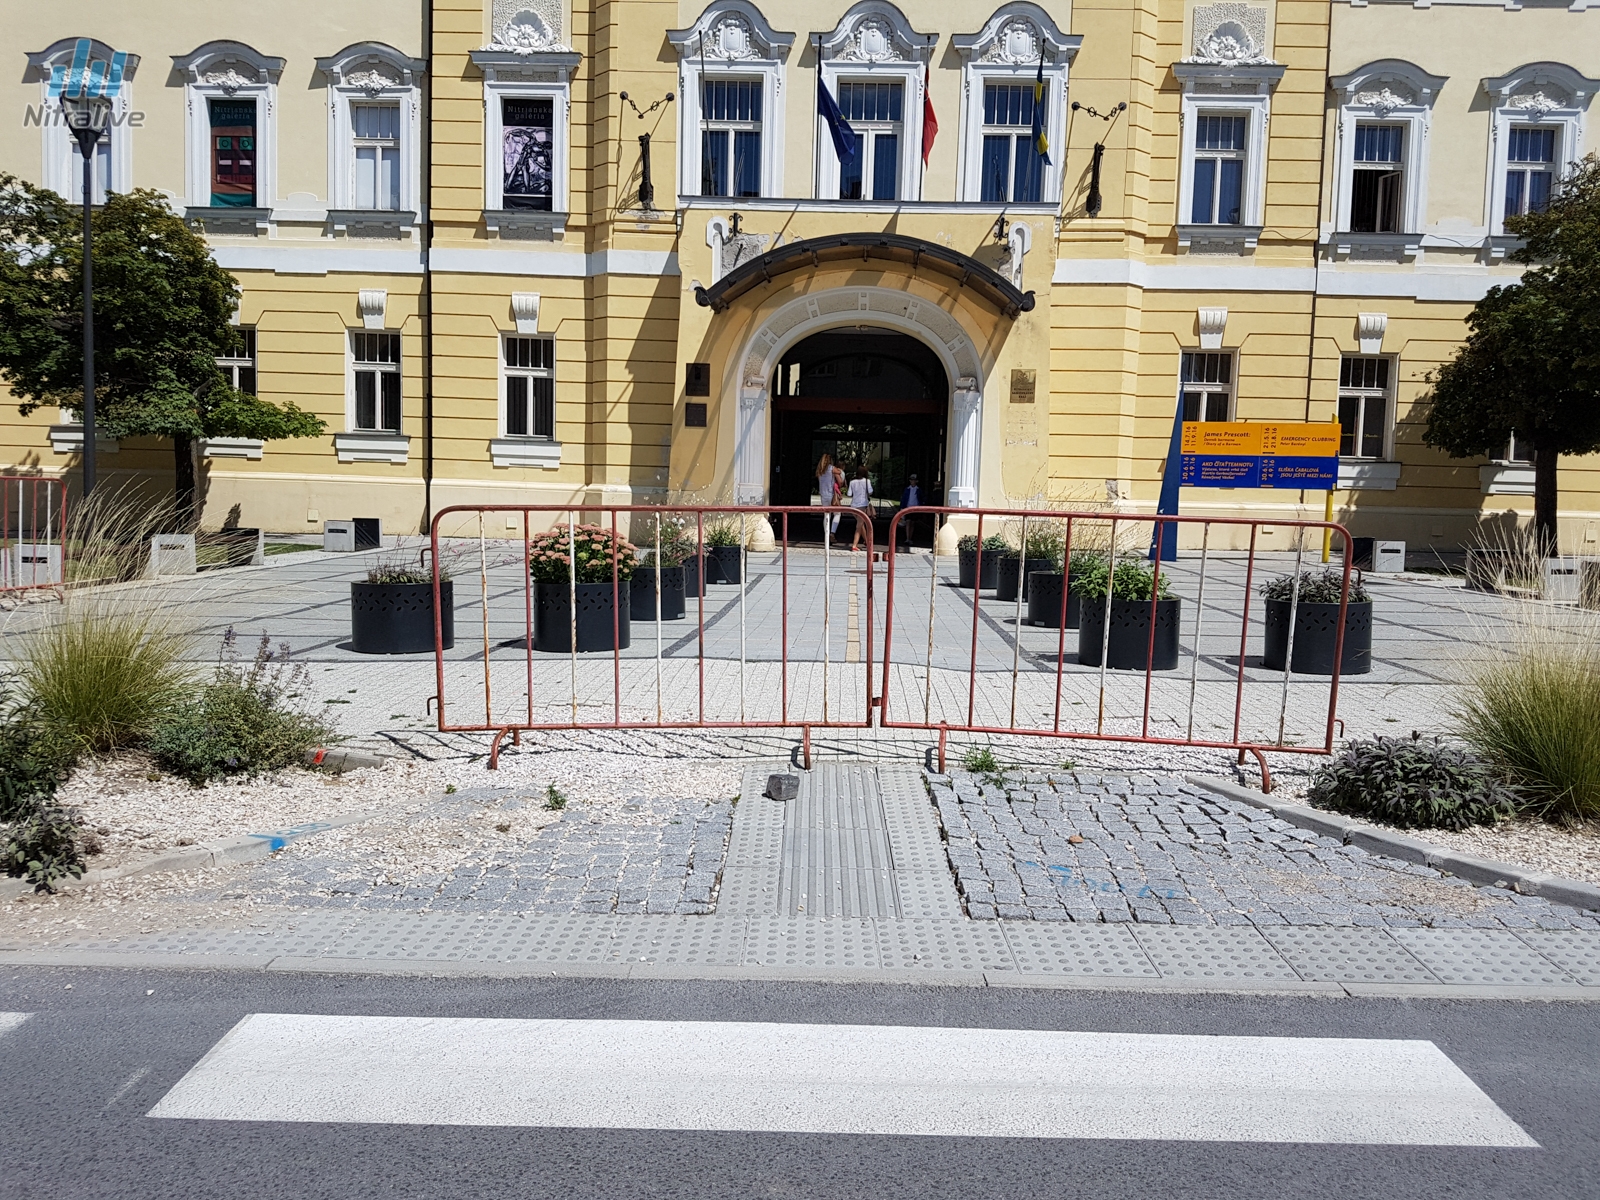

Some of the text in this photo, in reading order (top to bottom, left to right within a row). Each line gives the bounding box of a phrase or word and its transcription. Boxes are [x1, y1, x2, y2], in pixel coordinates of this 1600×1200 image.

[507, 105, 553, 113] Nitrianska
[514, 112, 545, 120] galéria
[1270, 427, 1278, 449] 21.8.16
